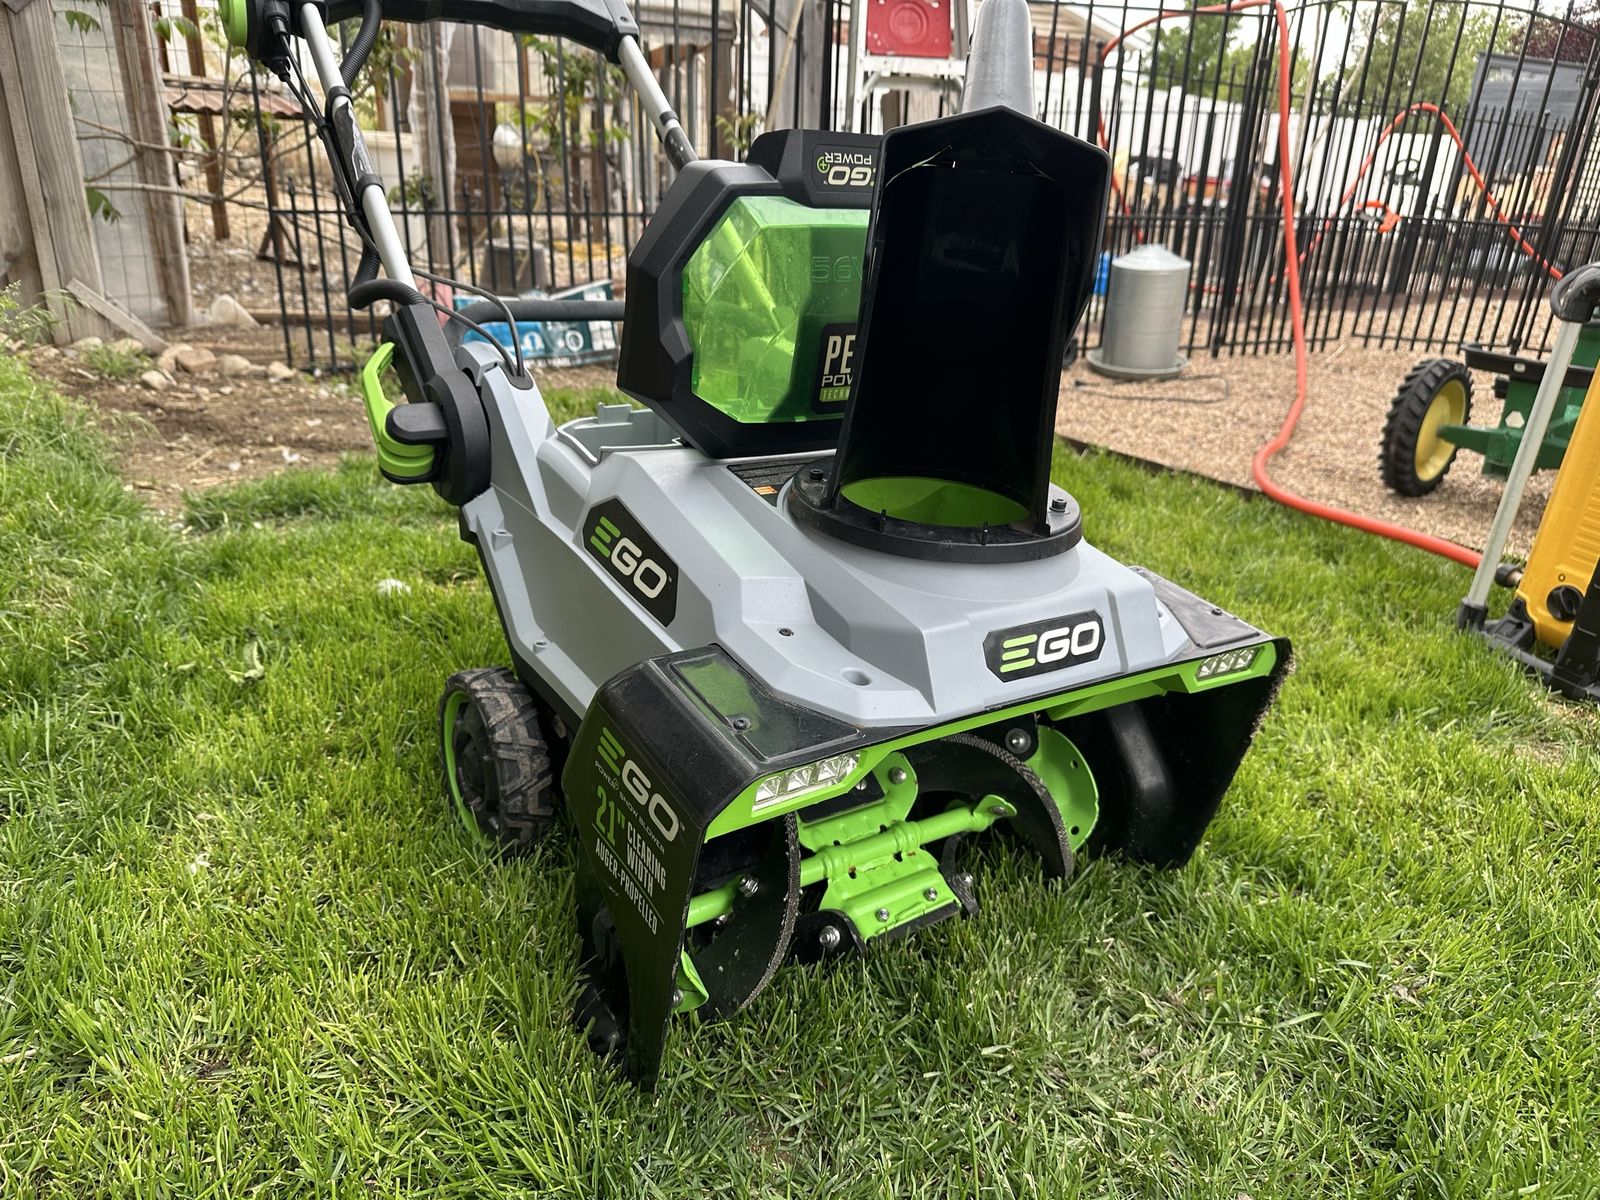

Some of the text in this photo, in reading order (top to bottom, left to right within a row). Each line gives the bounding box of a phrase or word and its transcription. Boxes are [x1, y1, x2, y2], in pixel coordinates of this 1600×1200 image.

[824, 152, 872, 165] POWER
[828, 165, 877, 187] GO
[590, 516, 667, 599] EGO
[1000, 620, 1100, 673] EGO
[597, 727, 679, 842] EGO
[619, 792, 637, 822] SNOW
[638, 814, 665, 855] BLOWER
[595, 838, 658, 935] AUGER-PROPELLED
[627, 822, 666, 891] CLEARING
[627, 848, 654, 897] WIDTH
